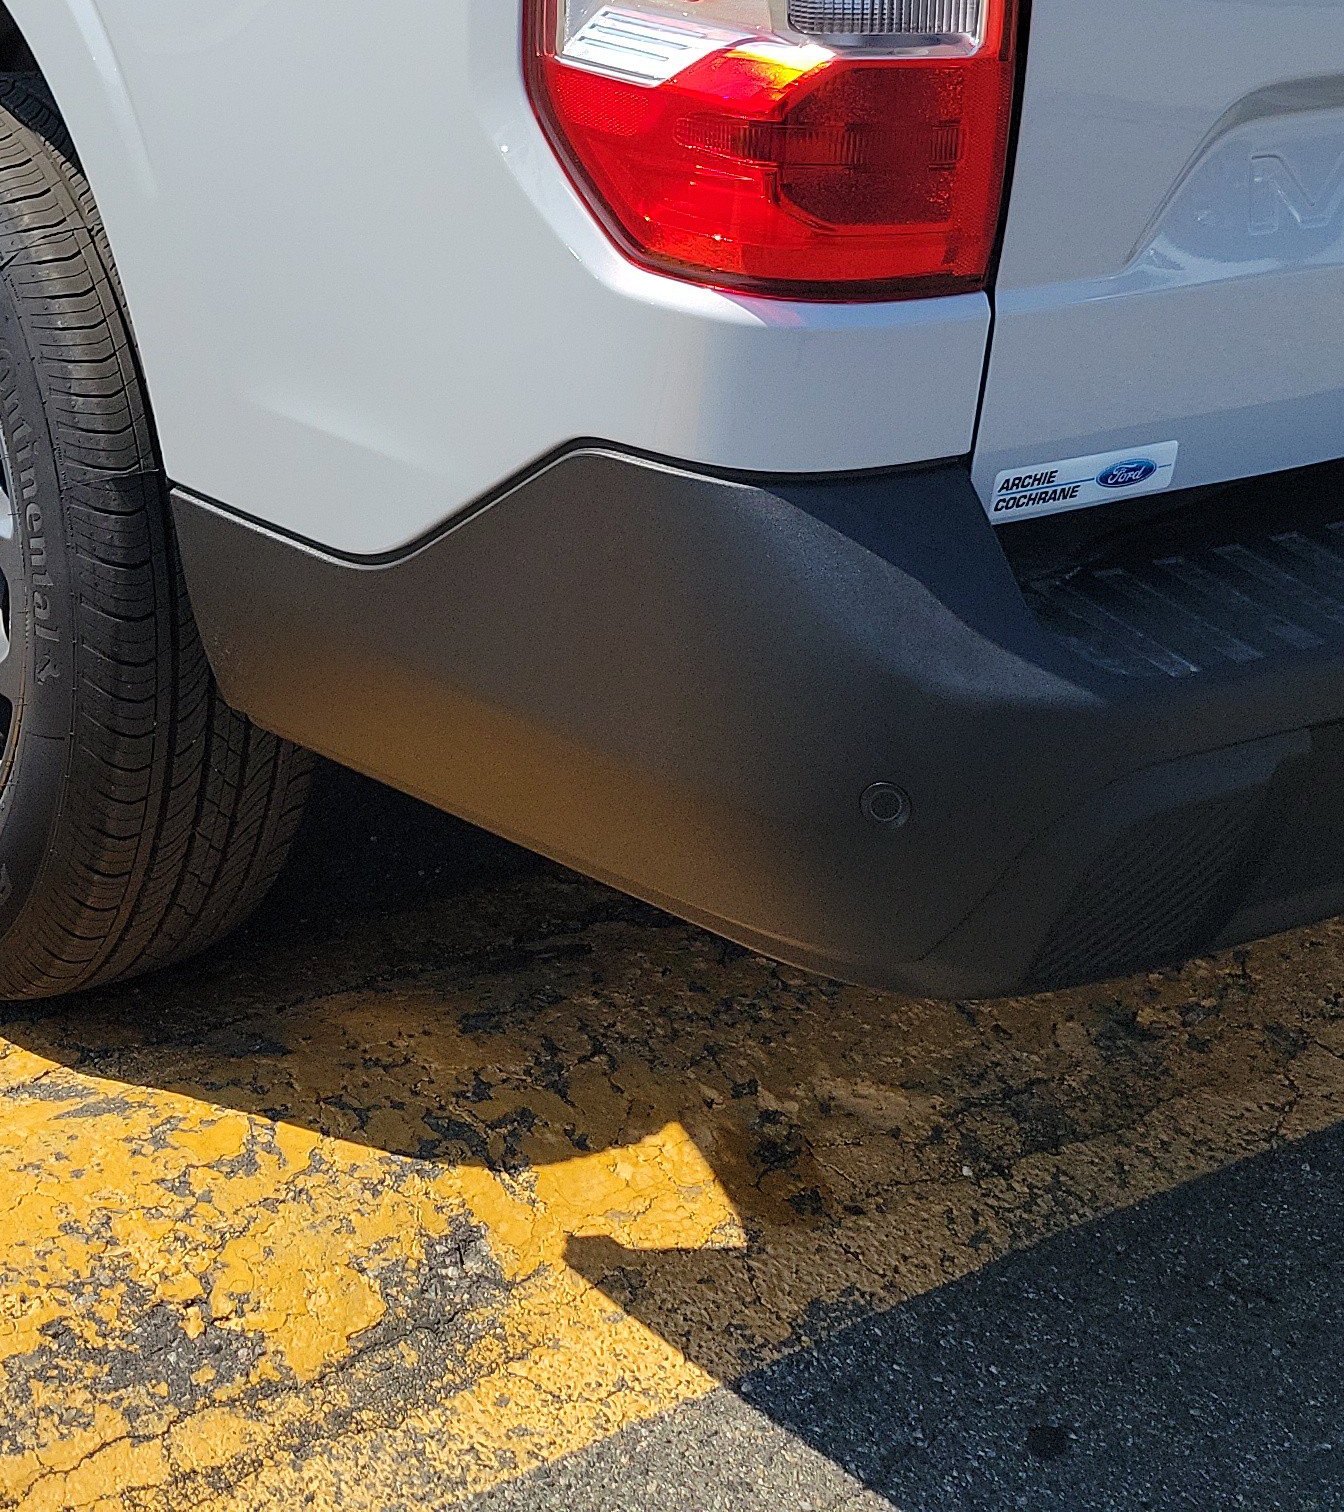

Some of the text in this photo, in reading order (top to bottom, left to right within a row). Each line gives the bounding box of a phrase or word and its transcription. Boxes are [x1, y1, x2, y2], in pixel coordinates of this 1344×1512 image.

[997, 463, 1144, 494] ARCHIE Ford
[993, 484, 1081, 512] COCHRANE
